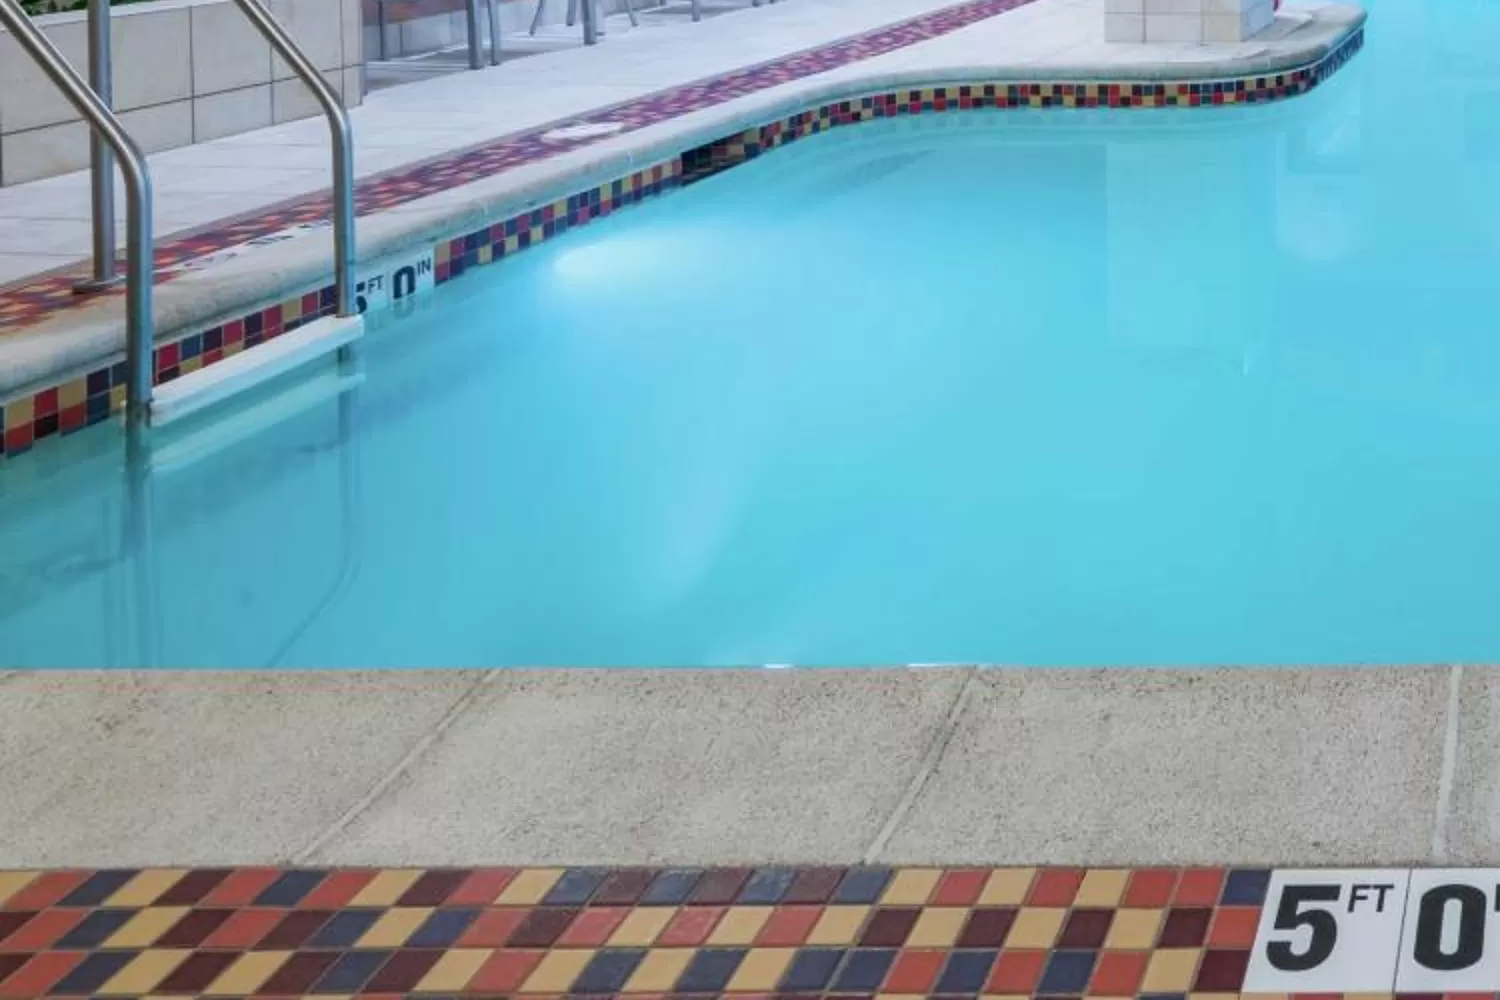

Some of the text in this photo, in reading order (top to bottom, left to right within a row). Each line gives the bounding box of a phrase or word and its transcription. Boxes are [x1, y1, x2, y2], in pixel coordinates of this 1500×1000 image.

[367, 275, 384, 293] FT
[417, 258, 431, 276] IN
[1266, 884, 1343, 971] 5
[1347, 884, 1394, 913] FT
